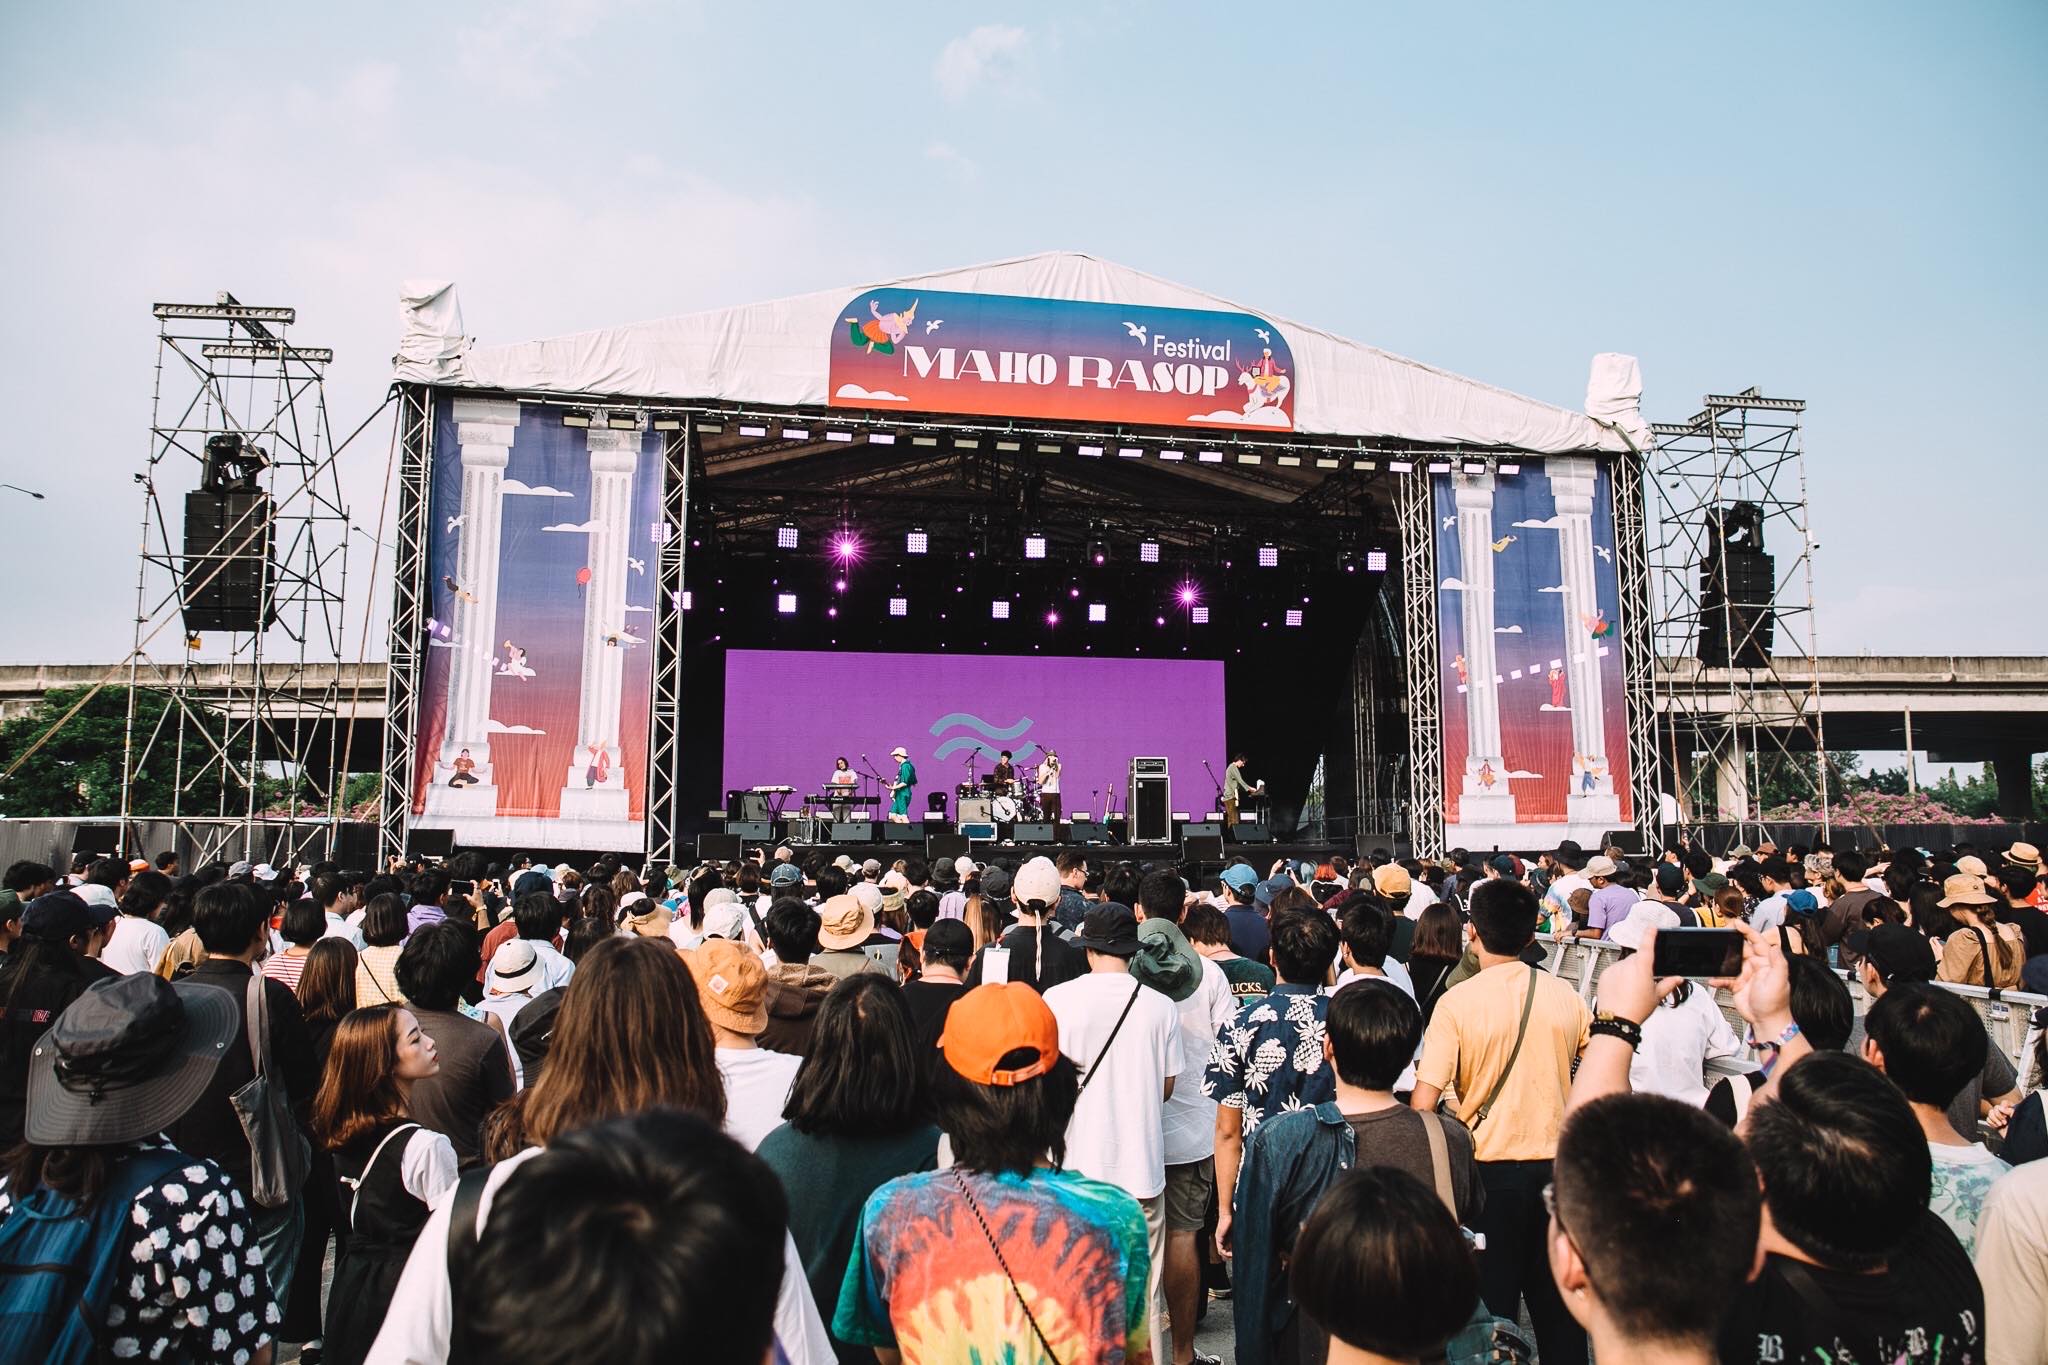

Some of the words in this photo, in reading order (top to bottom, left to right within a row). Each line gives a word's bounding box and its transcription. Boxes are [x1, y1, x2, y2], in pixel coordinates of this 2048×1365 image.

[1153, 334, 1231, 362] Festival
[903, 345, 1058, 386] MAHO
[1067, 355, 1230, 397] RASOP
